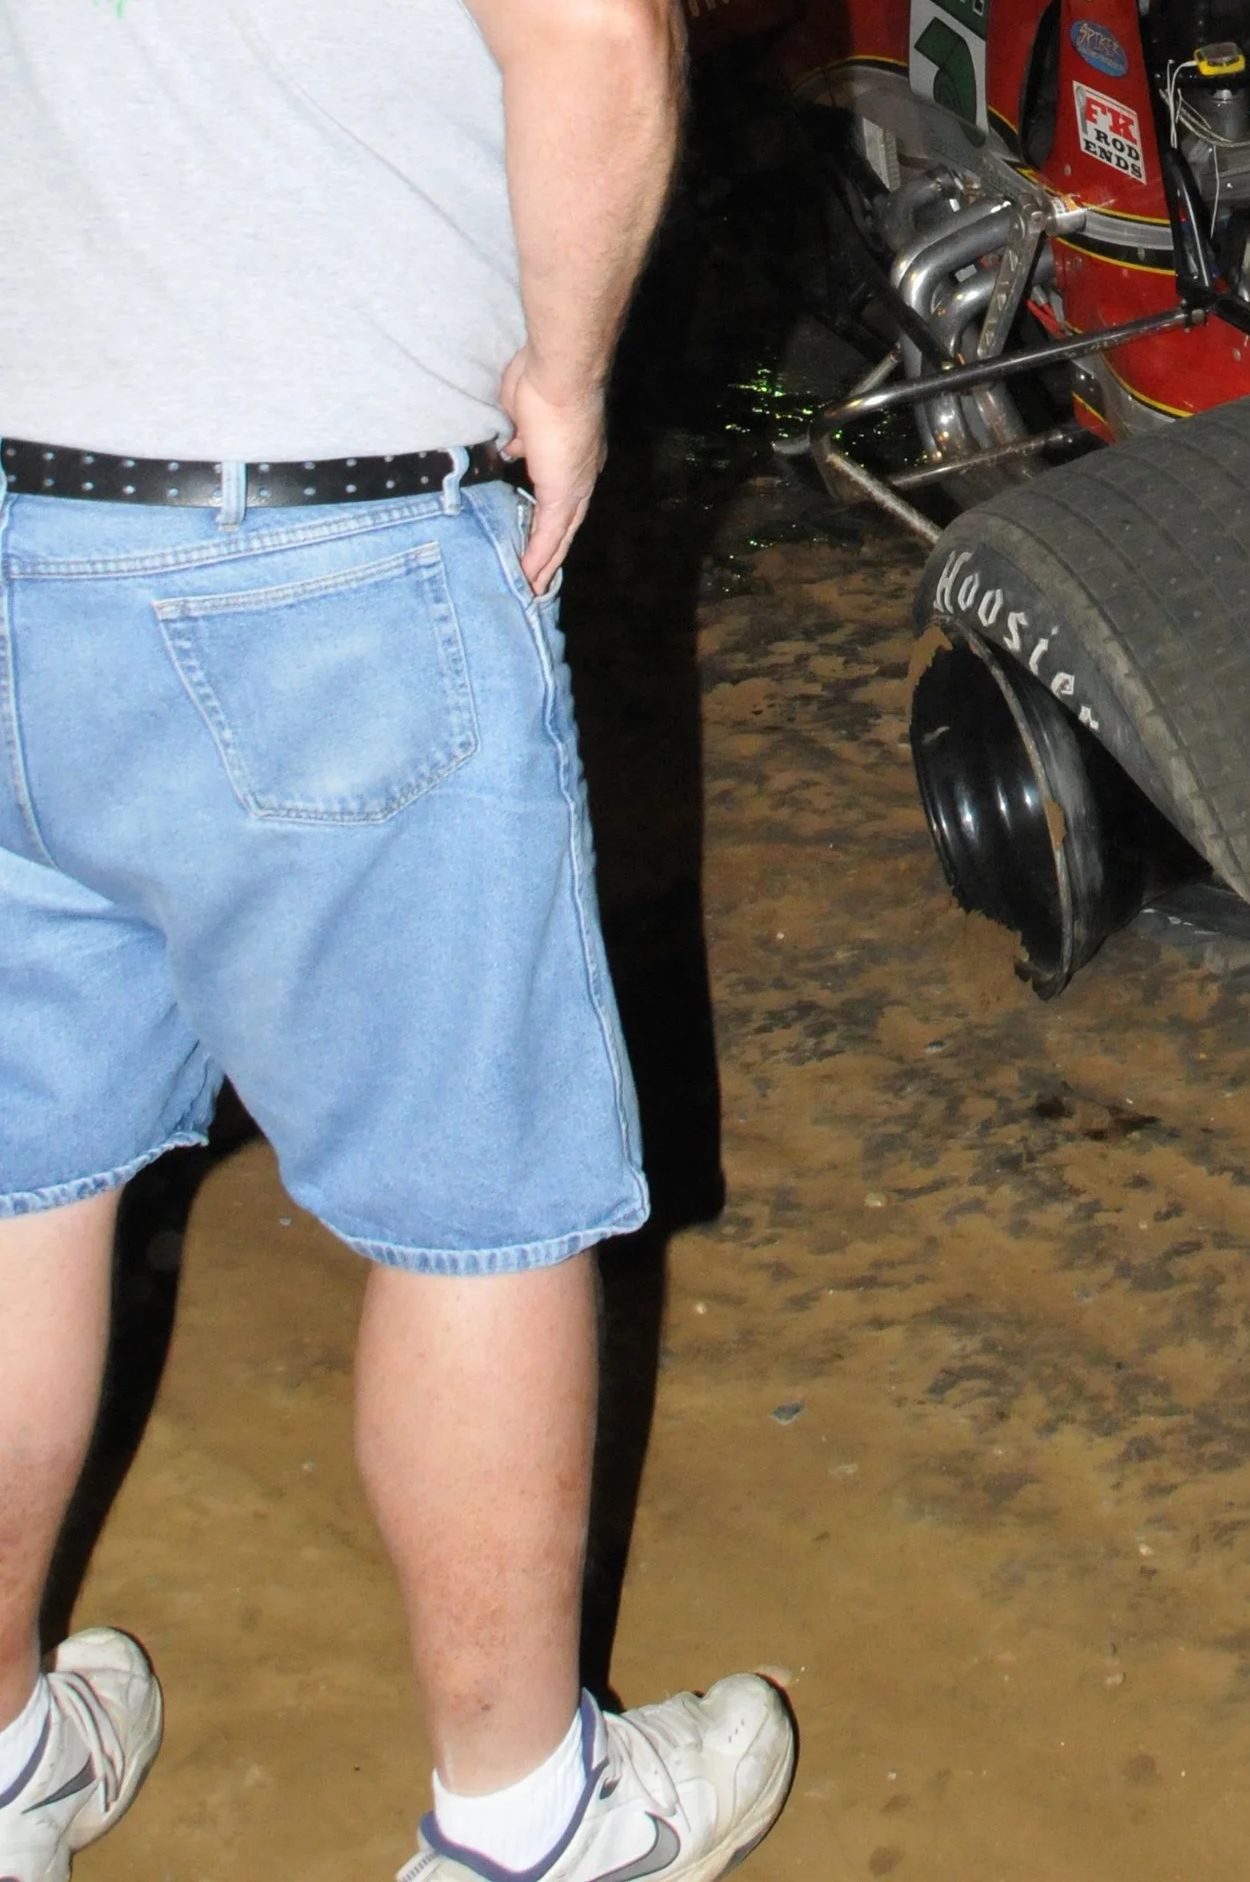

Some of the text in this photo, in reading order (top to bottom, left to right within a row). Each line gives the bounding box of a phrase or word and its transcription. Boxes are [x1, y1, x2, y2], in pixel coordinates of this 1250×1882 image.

[1084, 95, 1138, 144] FK
[1082, 138, 1143, 179] ENDS
[1094, 127, 1140, 161] ROD
